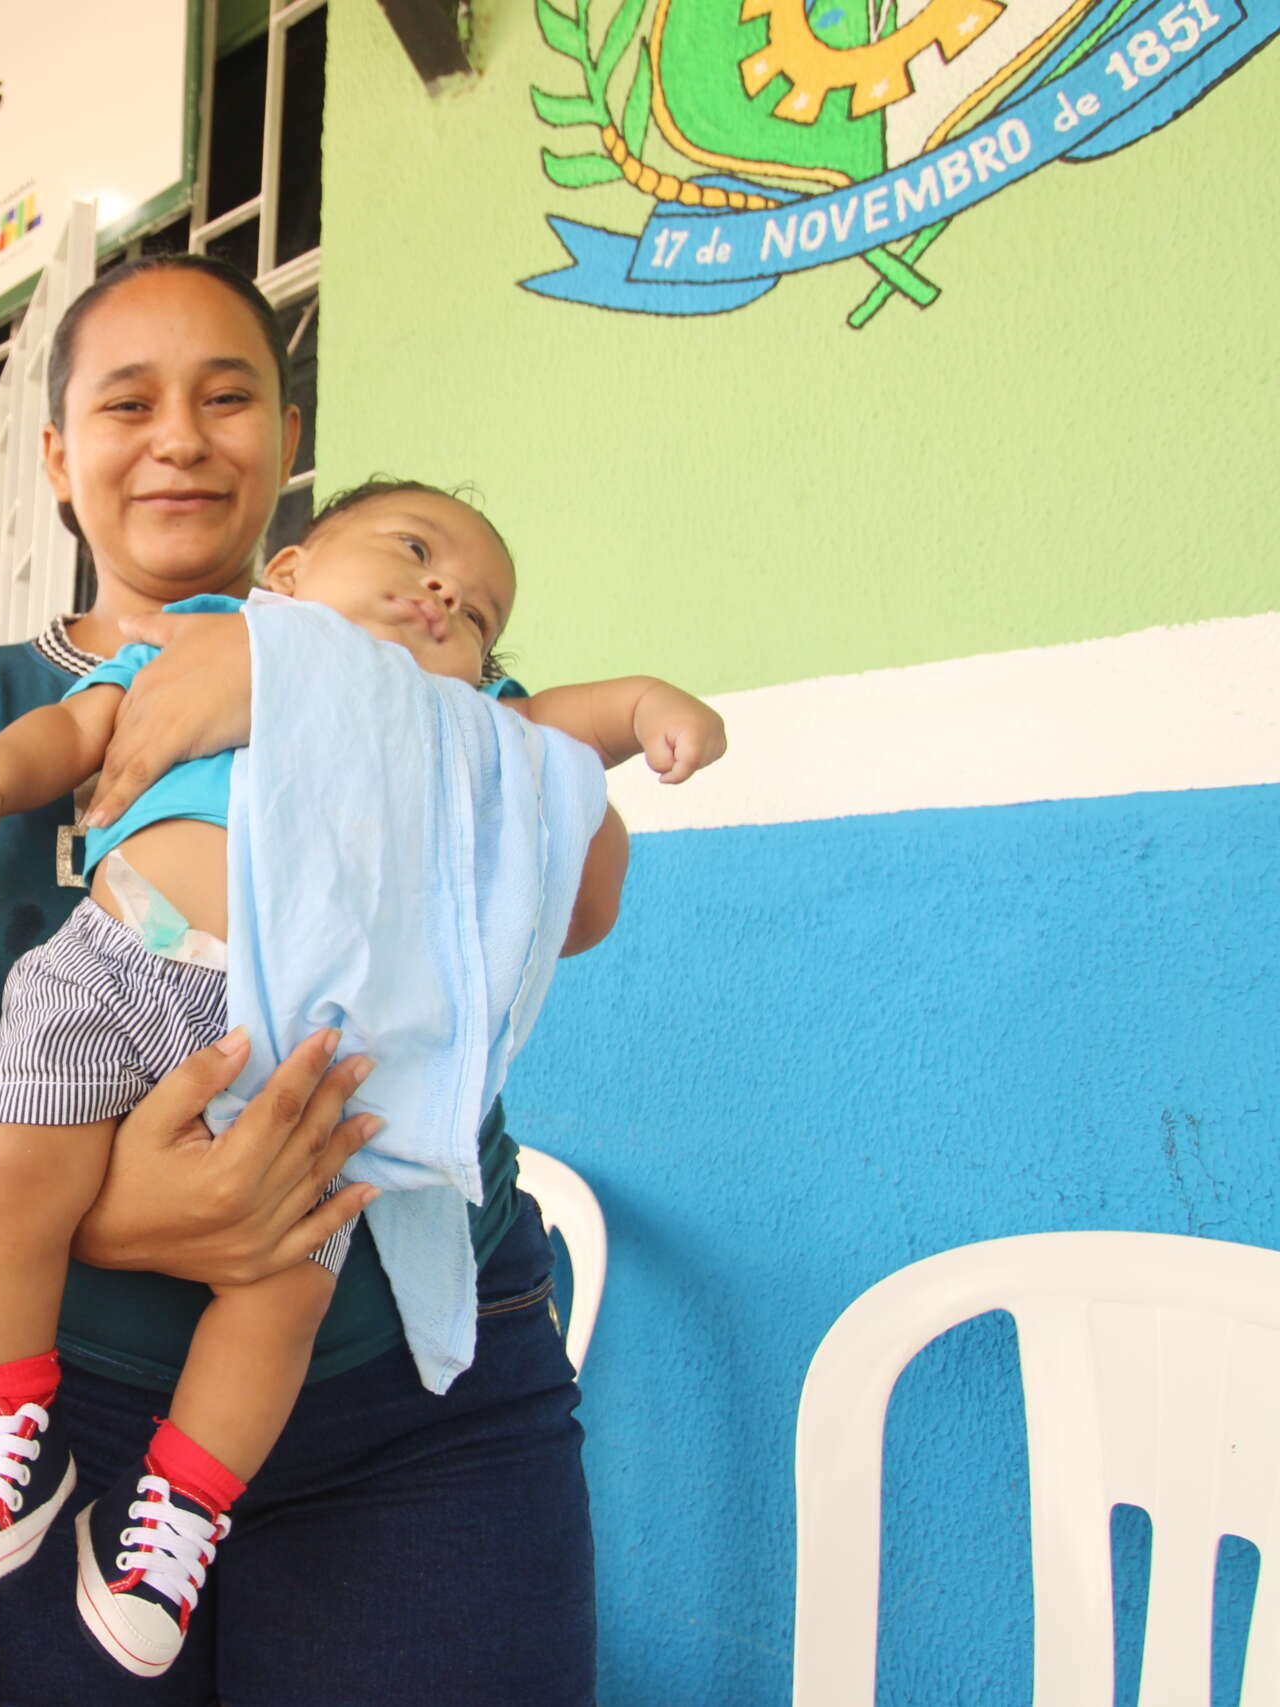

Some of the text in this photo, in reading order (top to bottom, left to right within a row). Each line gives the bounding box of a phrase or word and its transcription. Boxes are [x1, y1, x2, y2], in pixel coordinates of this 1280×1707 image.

[650, 0, 1220, 269] 17 de NOVEMBRO de 1851
